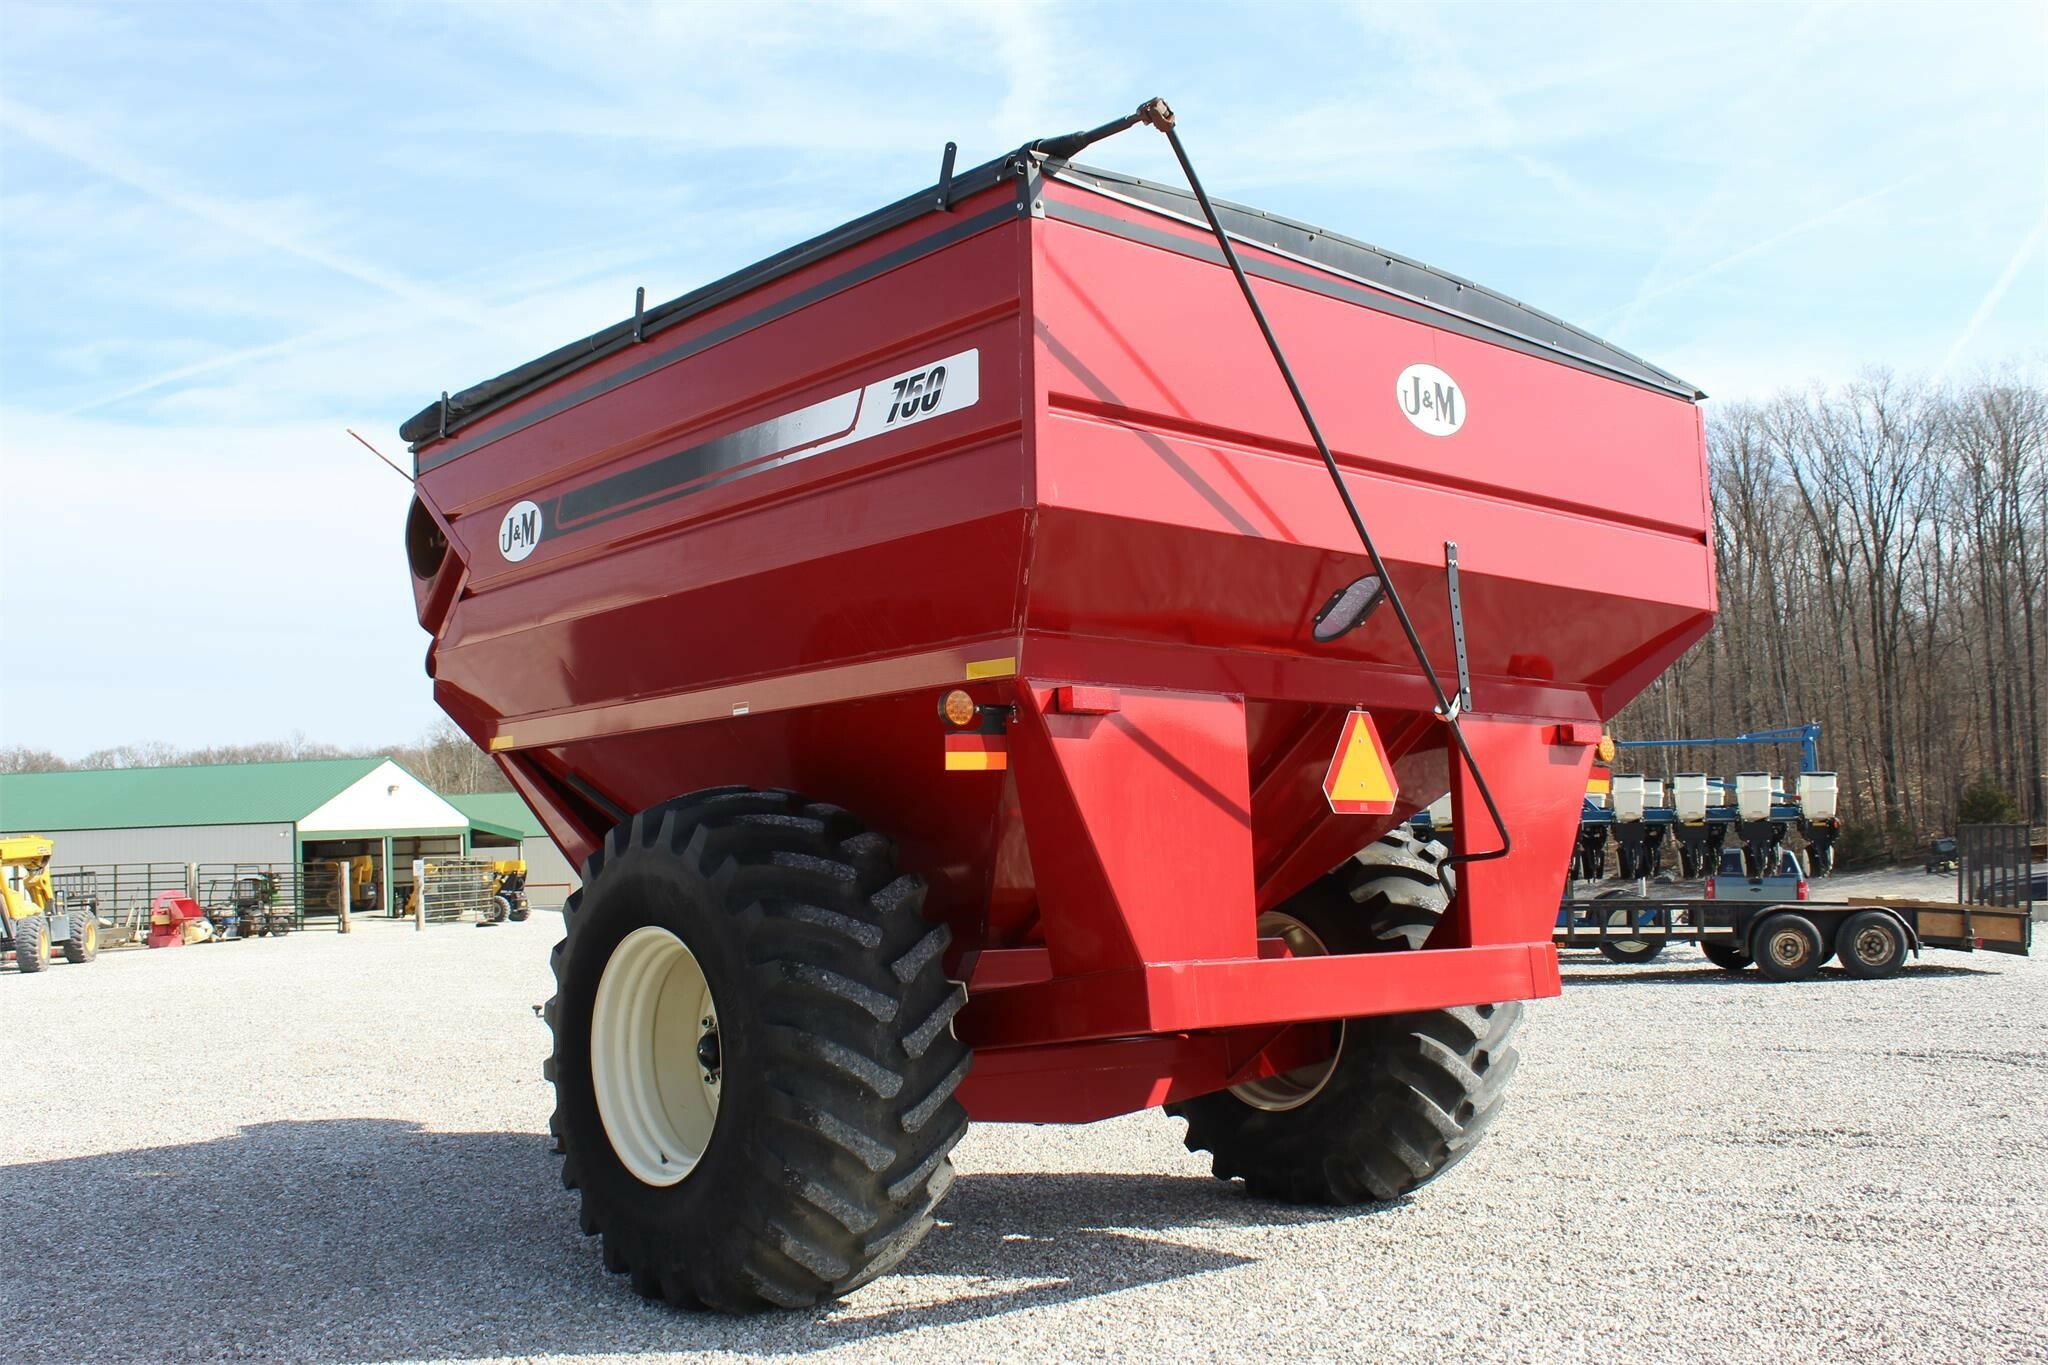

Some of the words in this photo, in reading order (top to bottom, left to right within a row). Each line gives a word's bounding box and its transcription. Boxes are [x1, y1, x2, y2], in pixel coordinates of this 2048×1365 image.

[886, 365, 947, 424] 750
[1402, 375, 1457, 426] J&M
[501, 509, 537, 553] J&M
